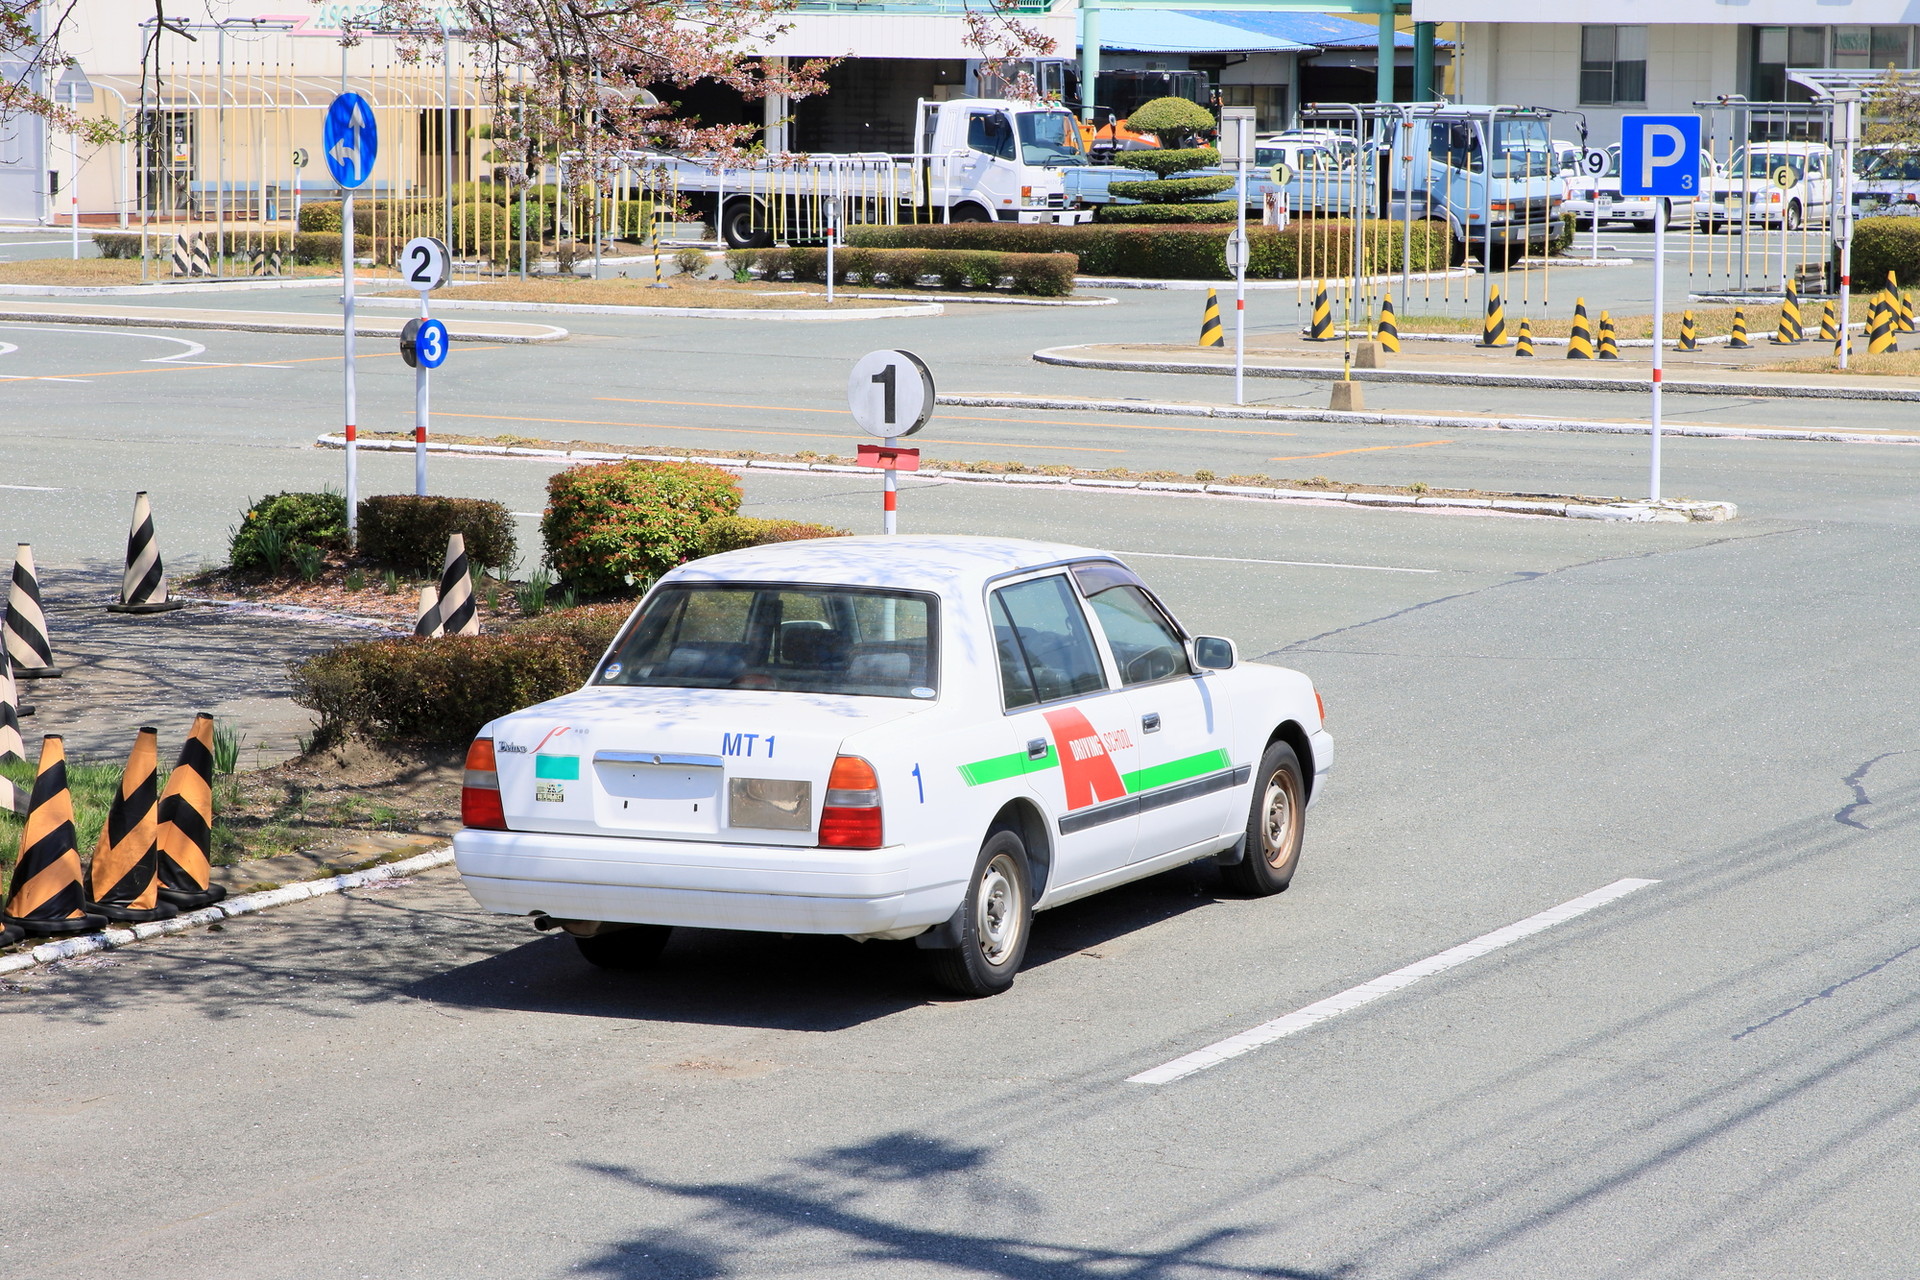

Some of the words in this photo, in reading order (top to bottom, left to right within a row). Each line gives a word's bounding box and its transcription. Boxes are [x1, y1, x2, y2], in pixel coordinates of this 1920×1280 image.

[293, 151, 300, 165] 2
[1588, 152, 1603, 173] 9
[1641, 124, 1686, 188] P
[1275, 167, 1283, 182] 1
[1681, 174, 1693, 189] 3
[1778, 170, 1788, 186] 6
[411, 246, 431, 282] 2
[424, 326, 442, 361] 3
[872, 365, 896, 424] 1
[722, 732, 759, 757] MT
[765, 735, 775, 758] 1
[1068, 734, 1104, 761] DRIVING
[1103, 729, 1133, 752] SCHOOL
[911, 762, 924, 804] 1
